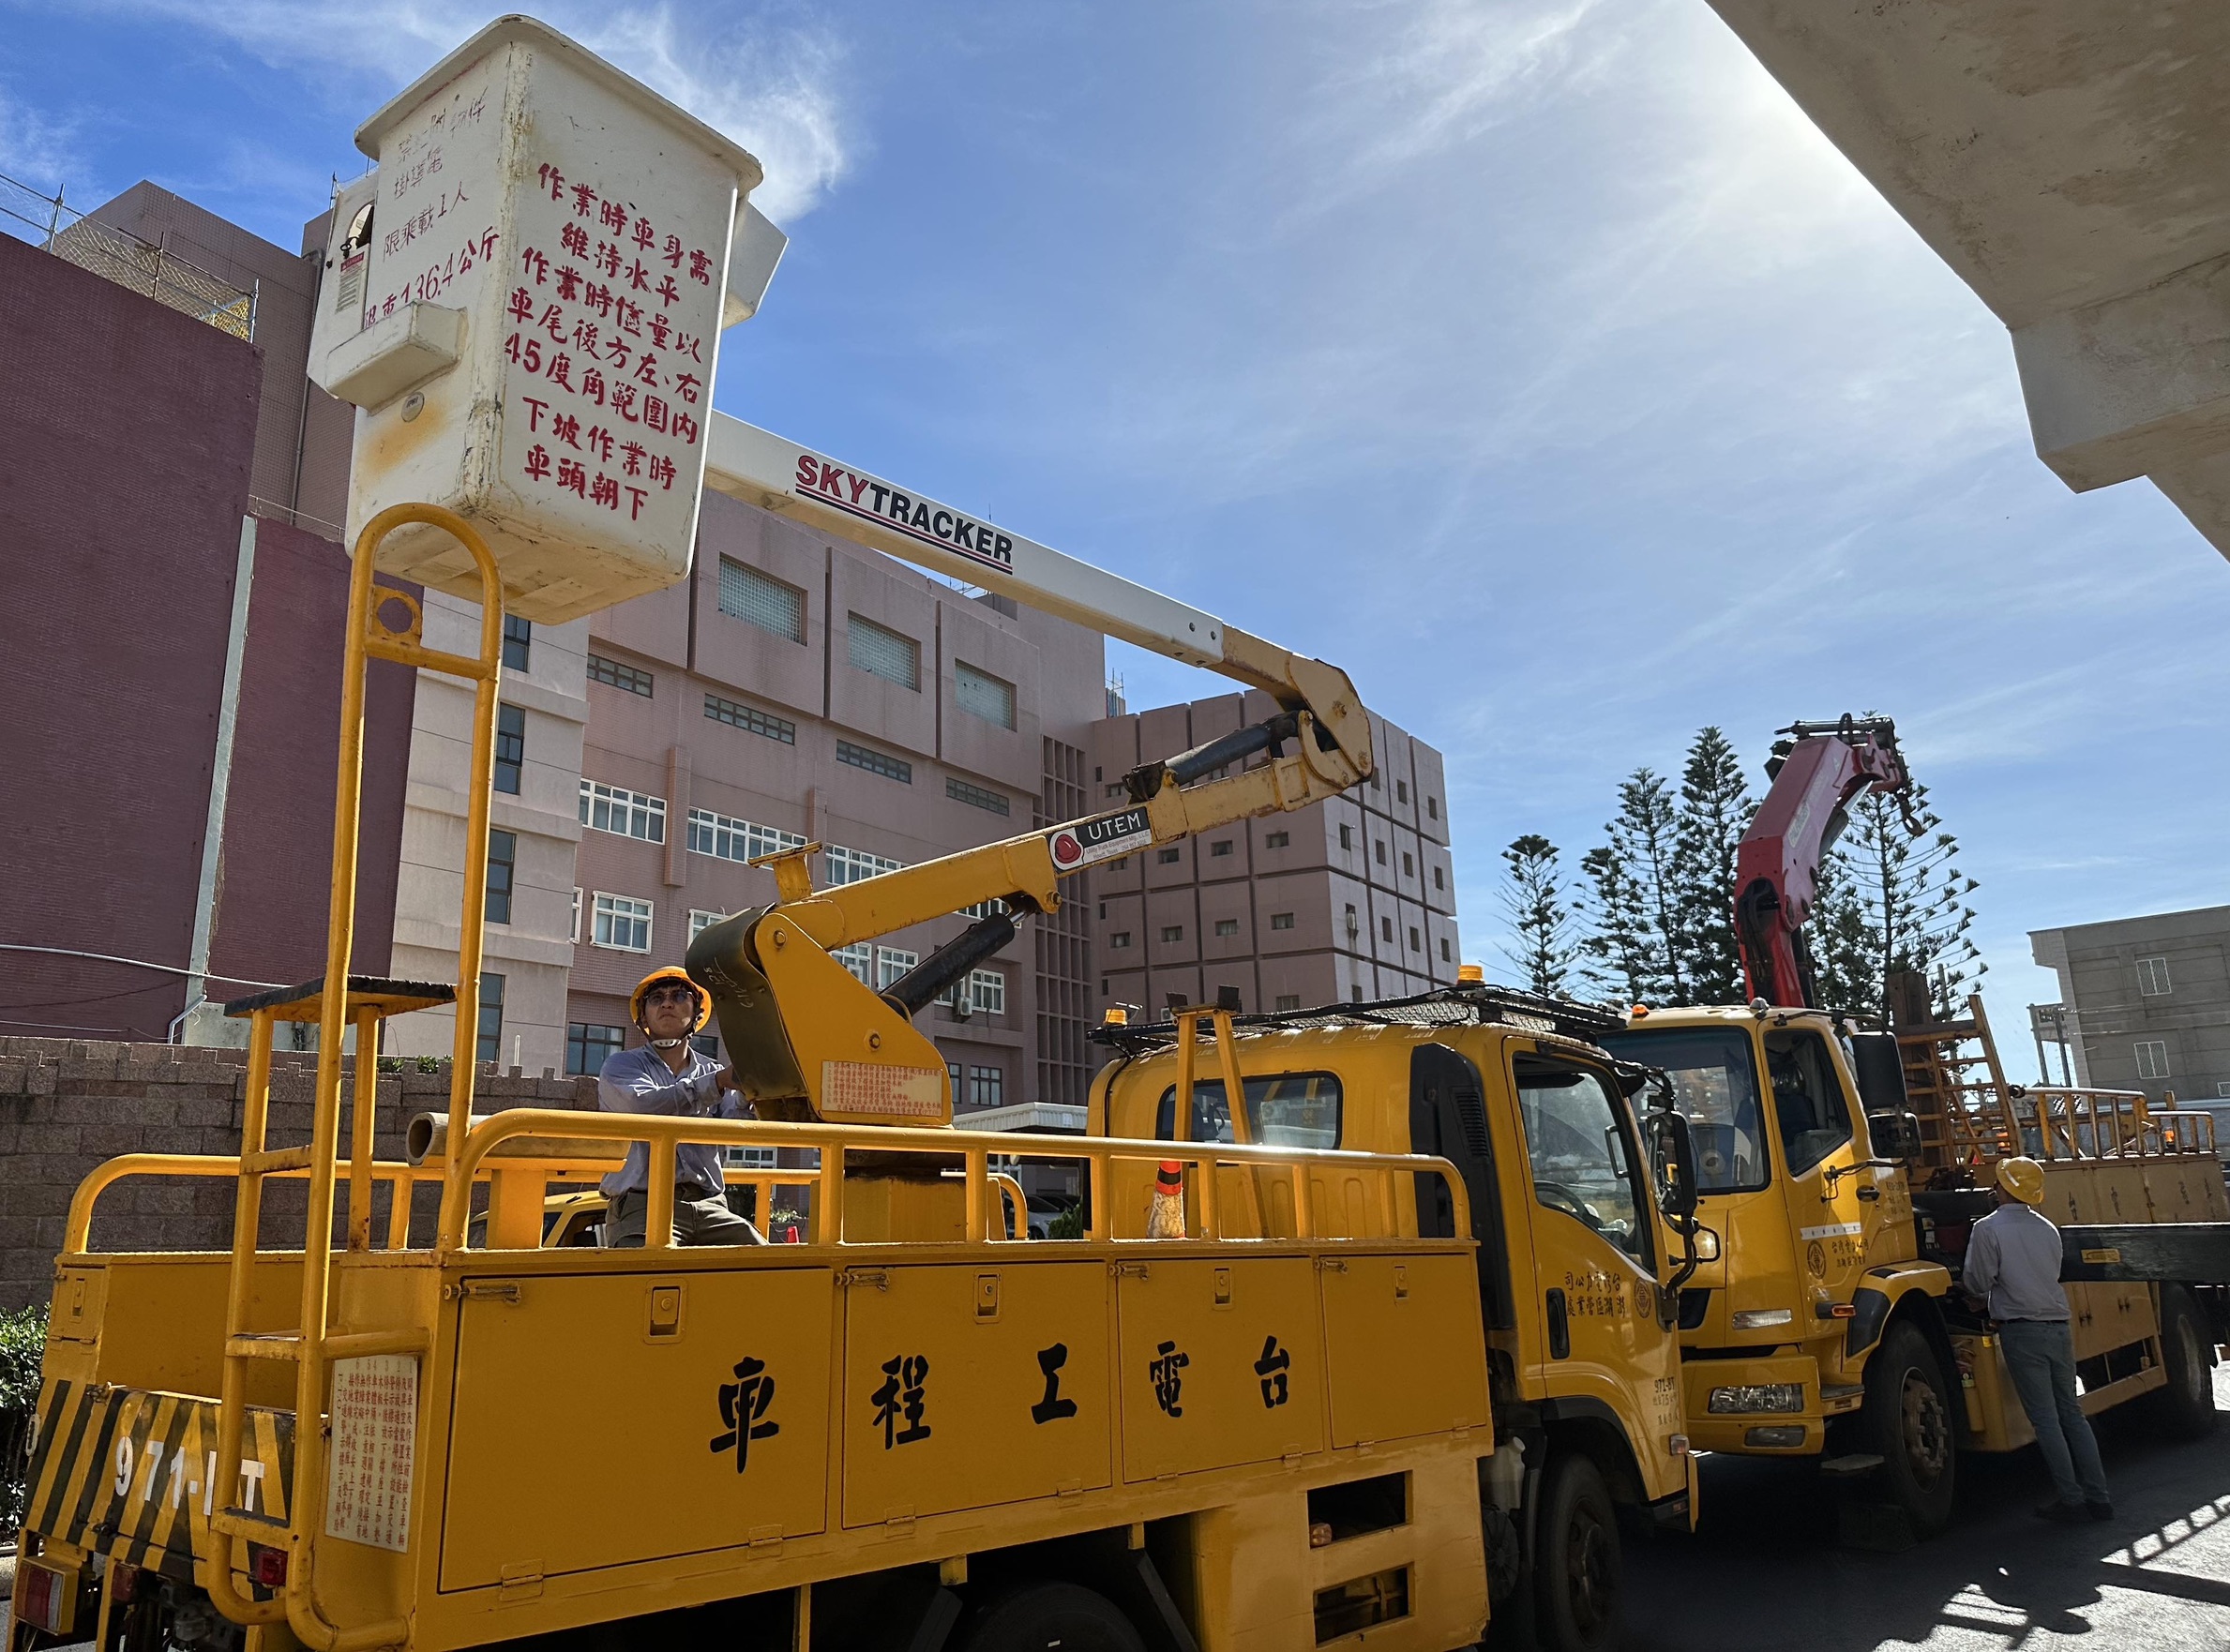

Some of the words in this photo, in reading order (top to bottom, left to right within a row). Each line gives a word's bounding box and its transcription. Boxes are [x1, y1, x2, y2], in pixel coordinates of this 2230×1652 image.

[538, 162, 713, 286] 作業時車身需
[561, 221, 680, 308] 維持水平
[521, 247, 701, 364] 作業時儘量以
[522, 396, 677, 490] 下坡作業時
[524, 443, 649, 521] 車頭朝下
[795, 455, 1014, 564] SKYTRACKER
[1088, 812, 1141, 840] UTEM
